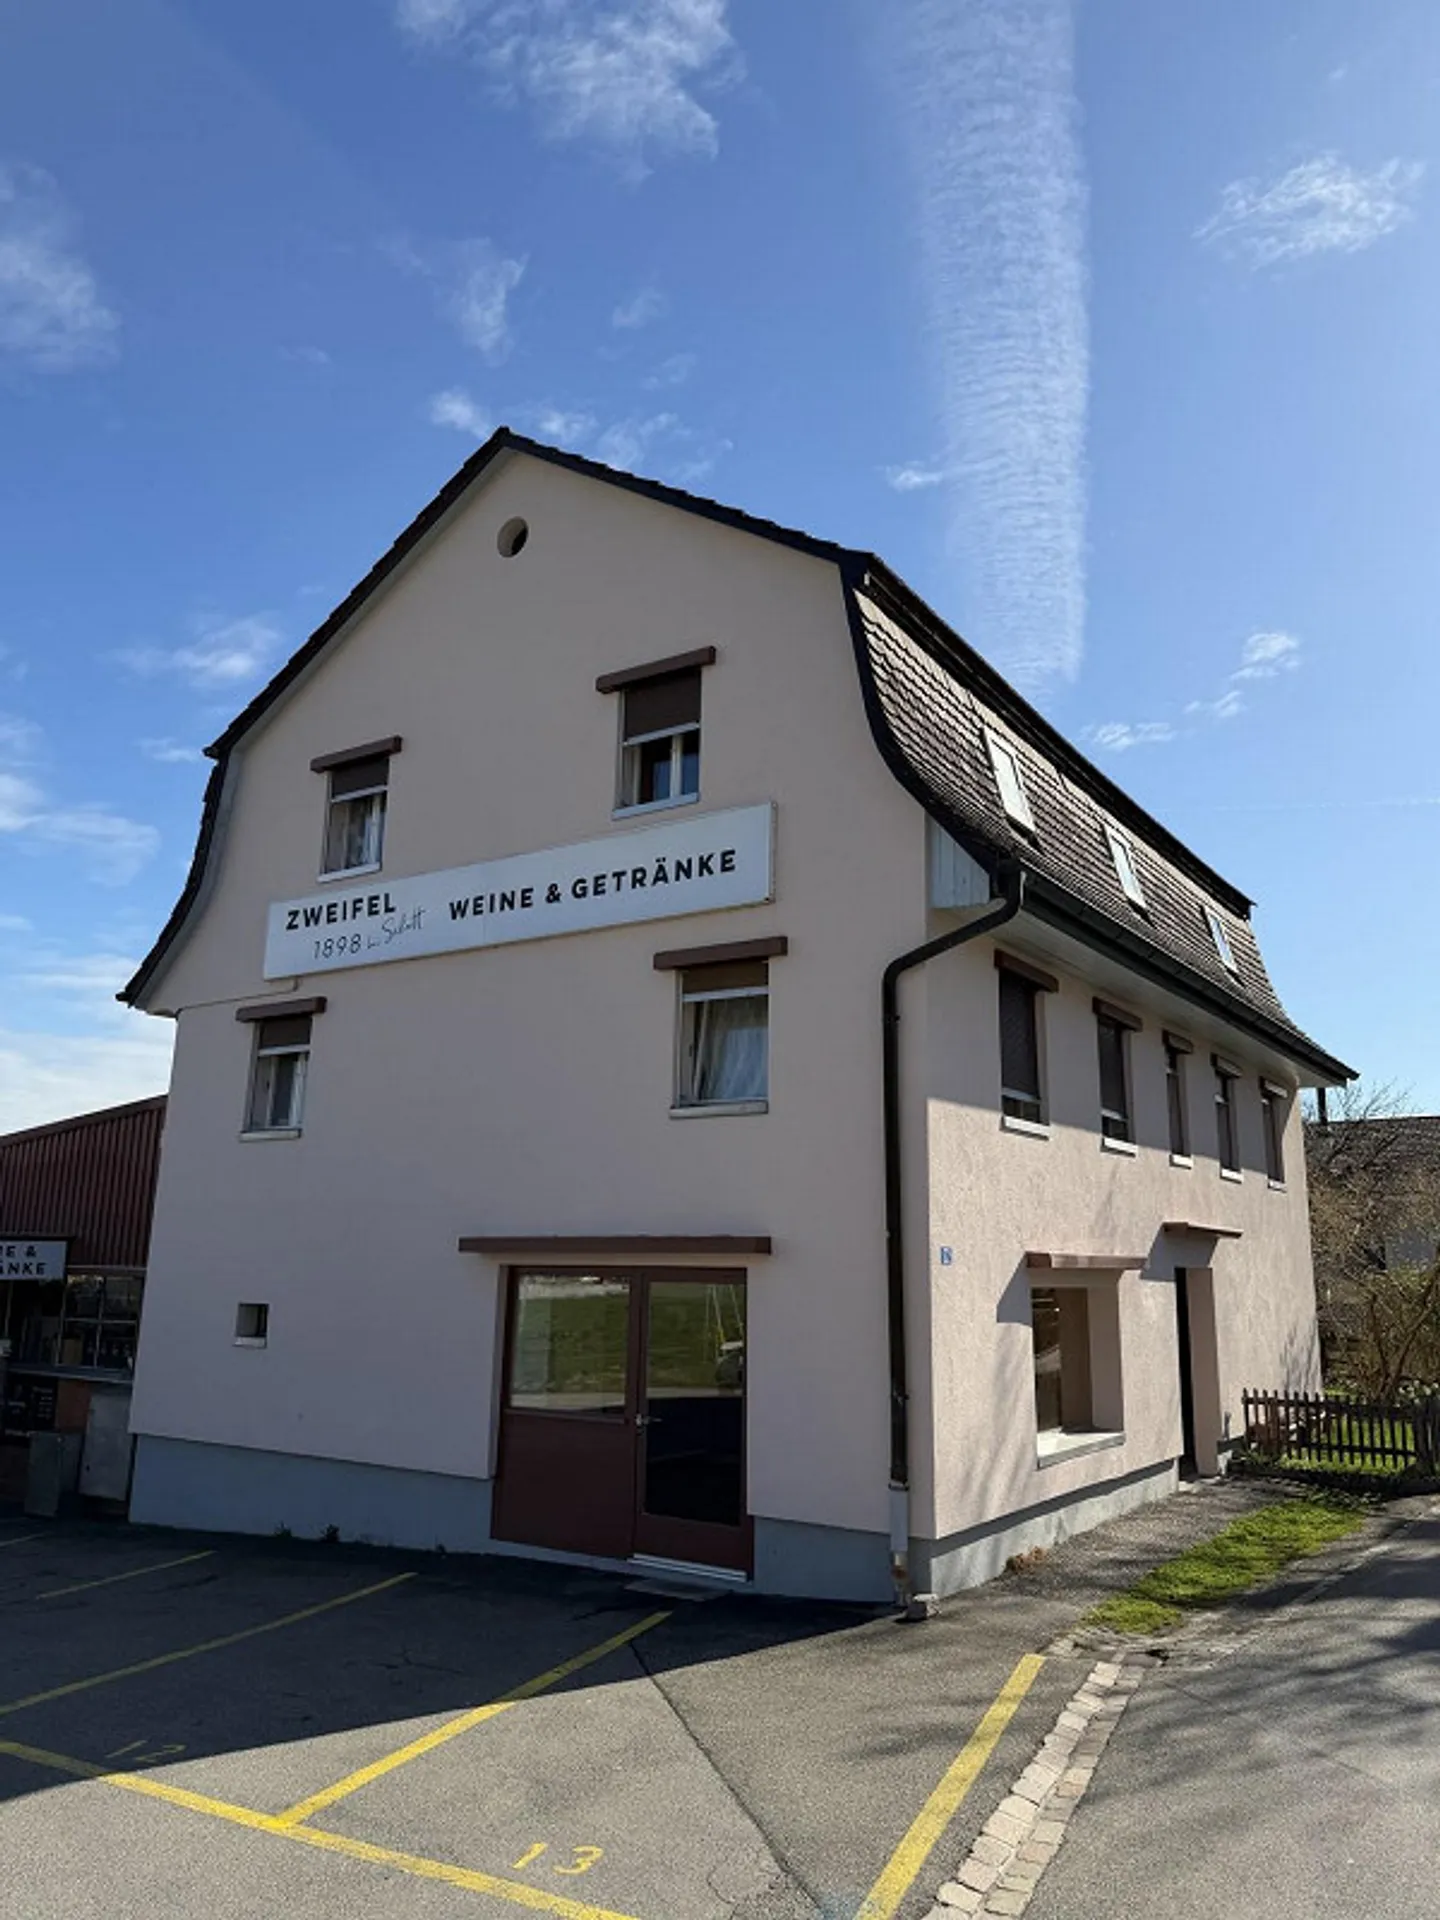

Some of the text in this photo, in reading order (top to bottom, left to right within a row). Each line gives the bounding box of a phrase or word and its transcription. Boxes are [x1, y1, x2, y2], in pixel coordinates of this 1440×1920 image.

[449, 849, 736, 920] WEINE & GETRÄNKE
[286, 893, 396, 931] ZWEIFEL
[314, 934, 361, 959] 1898
[0, 1245, 37, 1258] E &
[0, 1260, 46, 1275] NKE
[512, 1842, 604, 1875] 13
